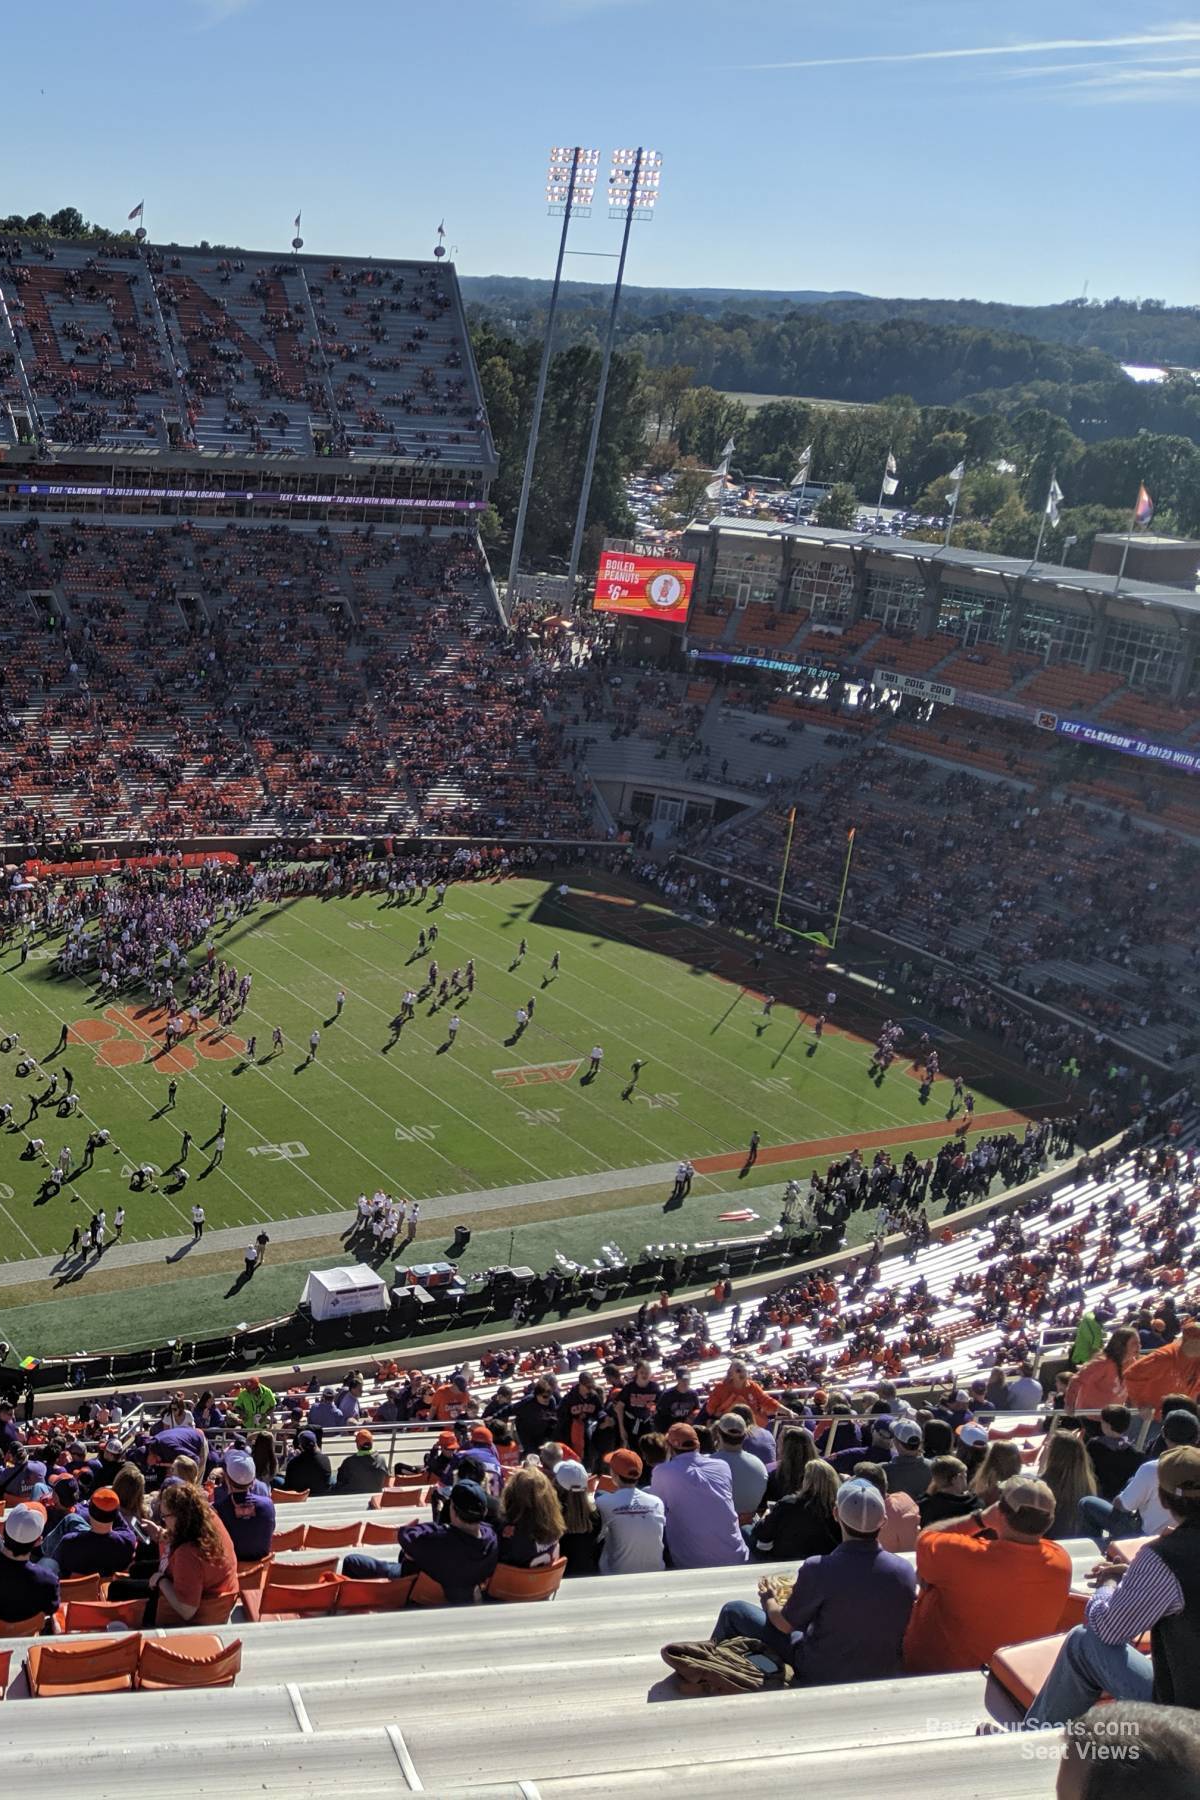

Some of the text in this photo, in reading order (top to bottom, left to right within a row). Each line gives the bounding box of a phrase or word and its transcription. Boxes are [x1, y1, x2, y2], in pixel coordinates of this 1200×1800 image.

[49, 487, 64, 495] TEXT
[107, 488, 114, 496] TO
[134, 489, 149, 497] WITH
[150, 489, 166, 497] YOUR
[185, 490, 198, 498] AND
[280, 493, 293, 501] TEXT
[344, 496, 363, 504] 20123
[605, 559, 636, 572] BOILED
[604, 569, 640, 585] PEANUTS
[807, 667, 817, 676] TO
[817, 669, 841, 680] 20123
[880, 672, 952, 697] 1981 2016 2018
[1061, 722, 1080, 734] TEXT
[1136, 742, 1148, 752] TO
[1148, 745, 1172, 760] 20123
[1173, 752, 1195, 765] WITH
[493, 1060, 580, 1088] ACC
[751, 1077, 791, 1093] 10
[637, 1090, 680, 1109] 20
[515, 1106, 562, 1126] 30
[394, 1124, 436, 1143] 40
[246, 1141, 310, 1162] 150
